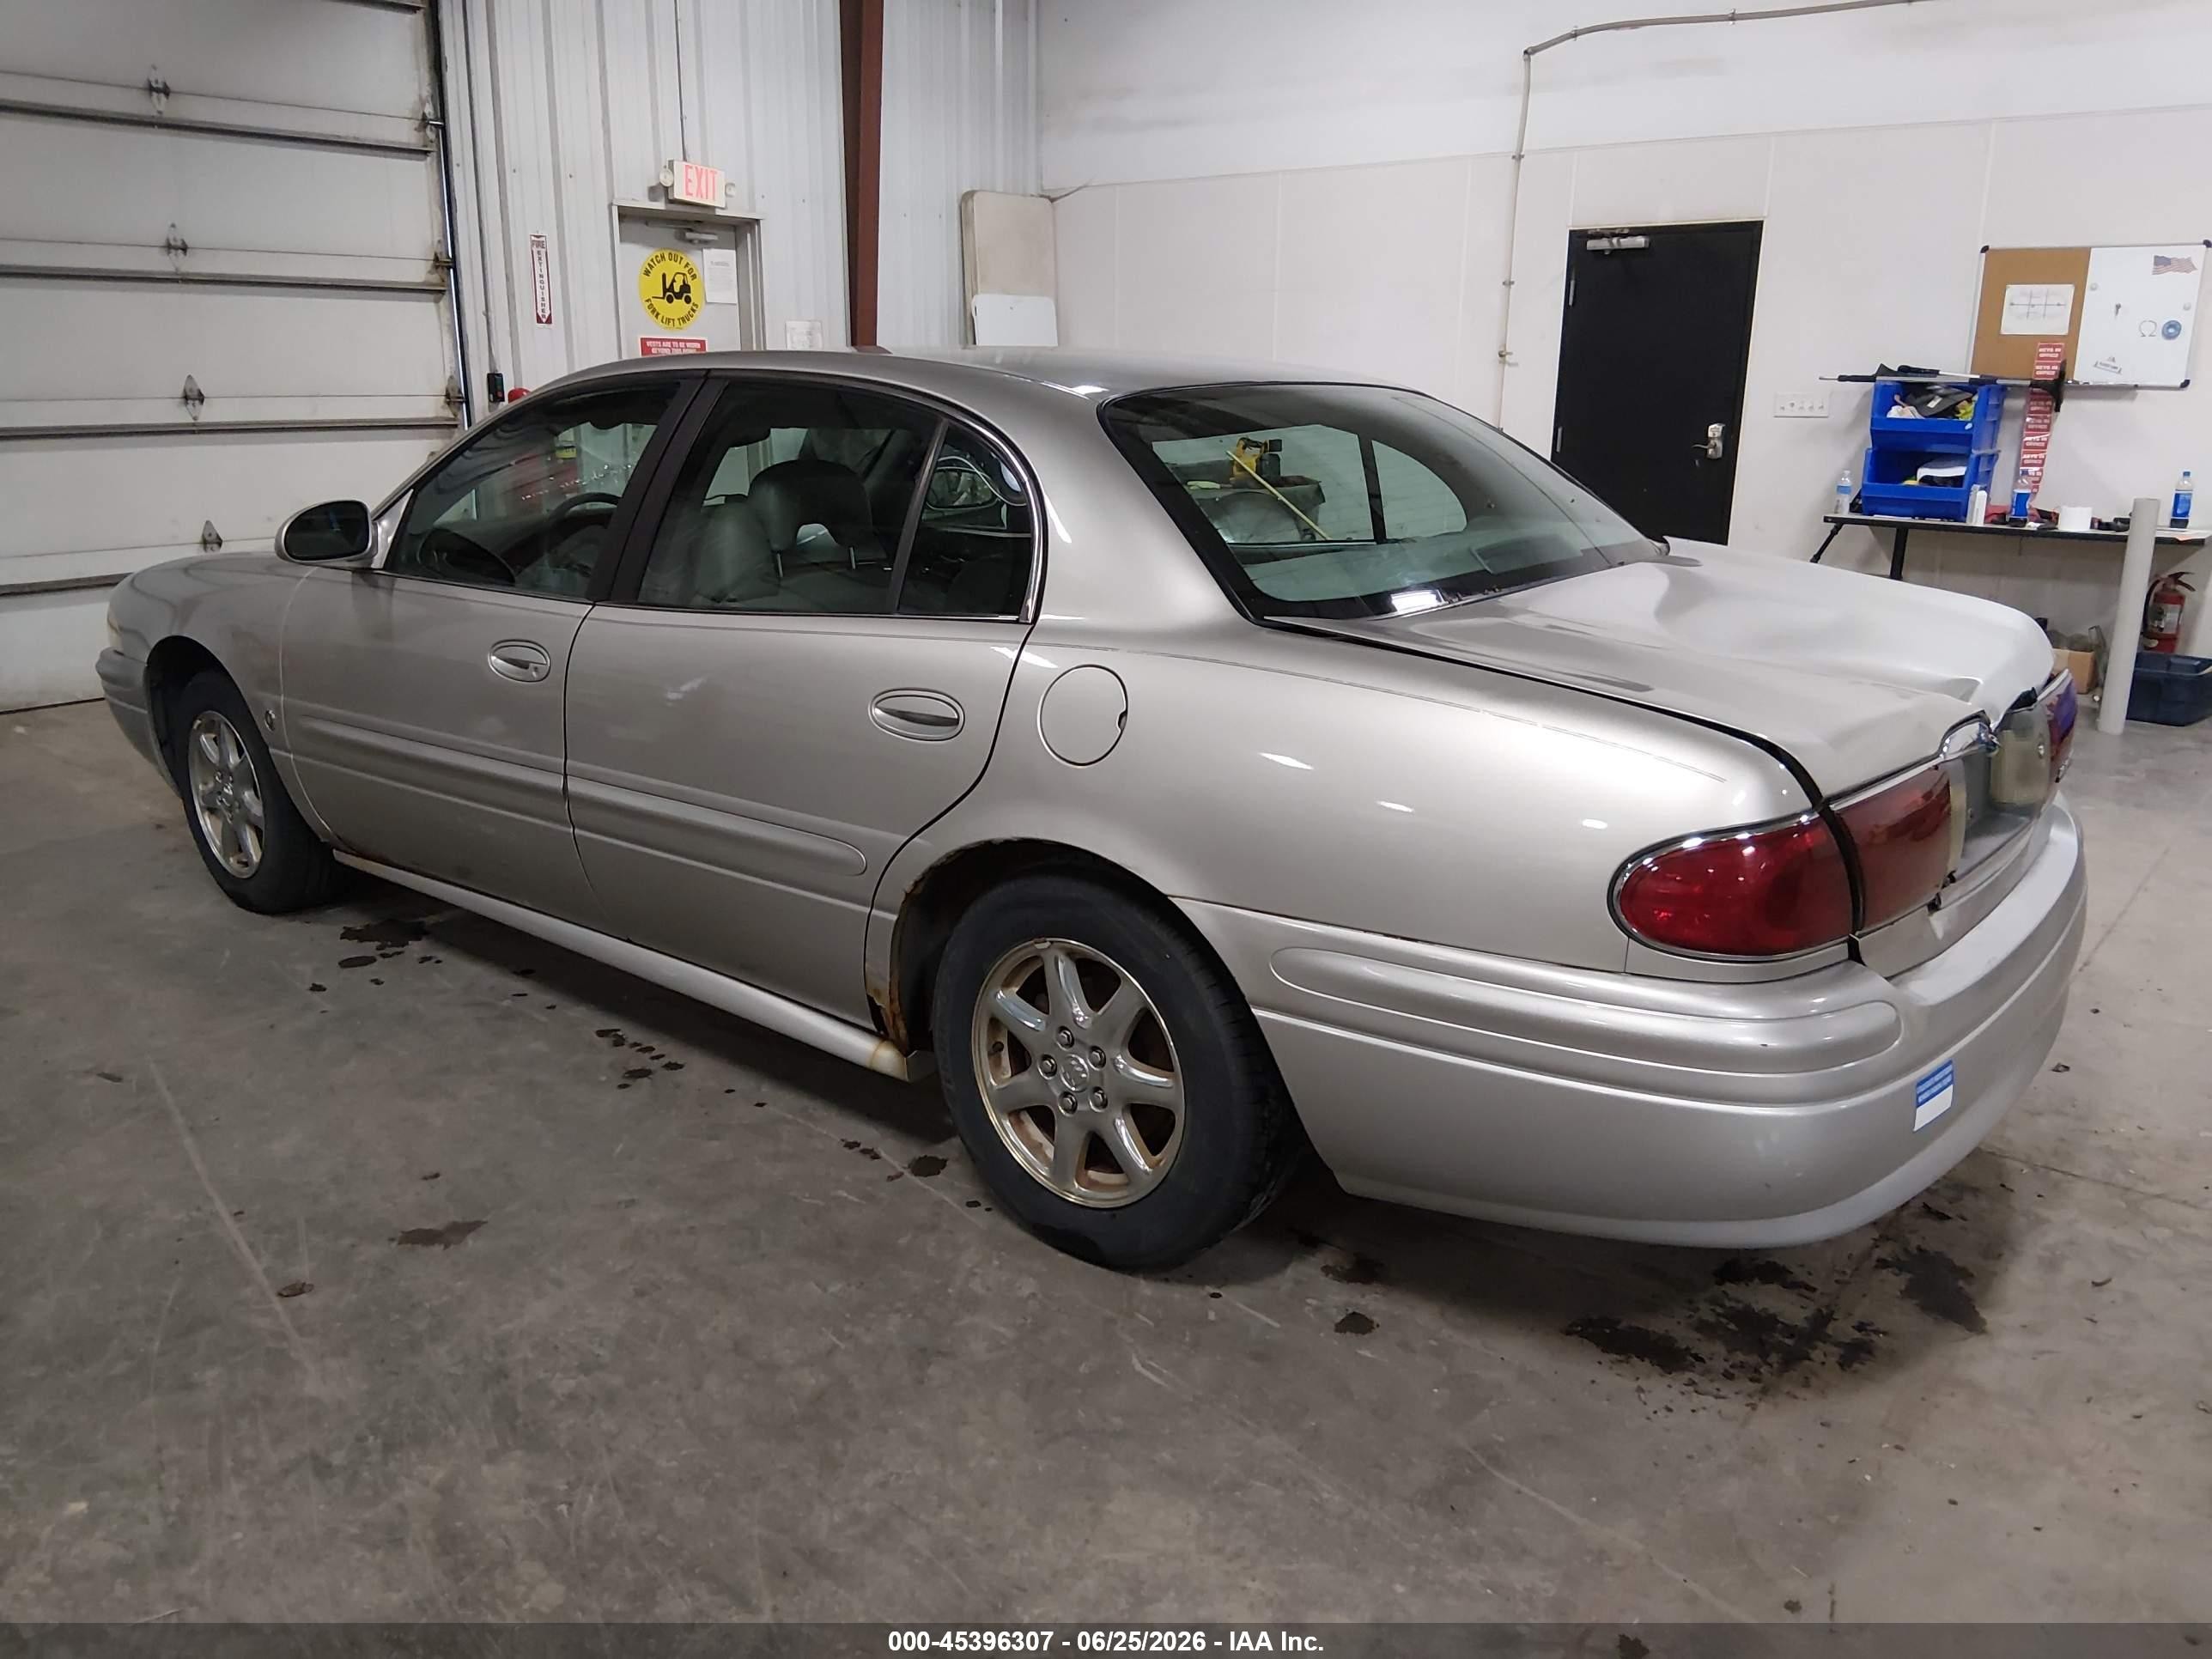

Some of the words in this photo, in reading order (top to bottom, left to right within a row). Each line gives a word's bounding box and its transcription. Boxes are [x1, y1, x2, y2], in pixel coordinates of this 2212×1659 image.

[685, 164, 717, 201] EXIT
[532, 240, 545, 249] FIRE
[643, 252, 666, 277] WATCH
[668, 252, 684, 265] OUT
[684, 262, 697, 281] FOR
[537, 250, 546, 319] EXTINGUISHER
[645, 298, 660, 320] FORK
[660, 315, 675, 327] LIFT
[677, 302, 699, 326] TRUCKS
